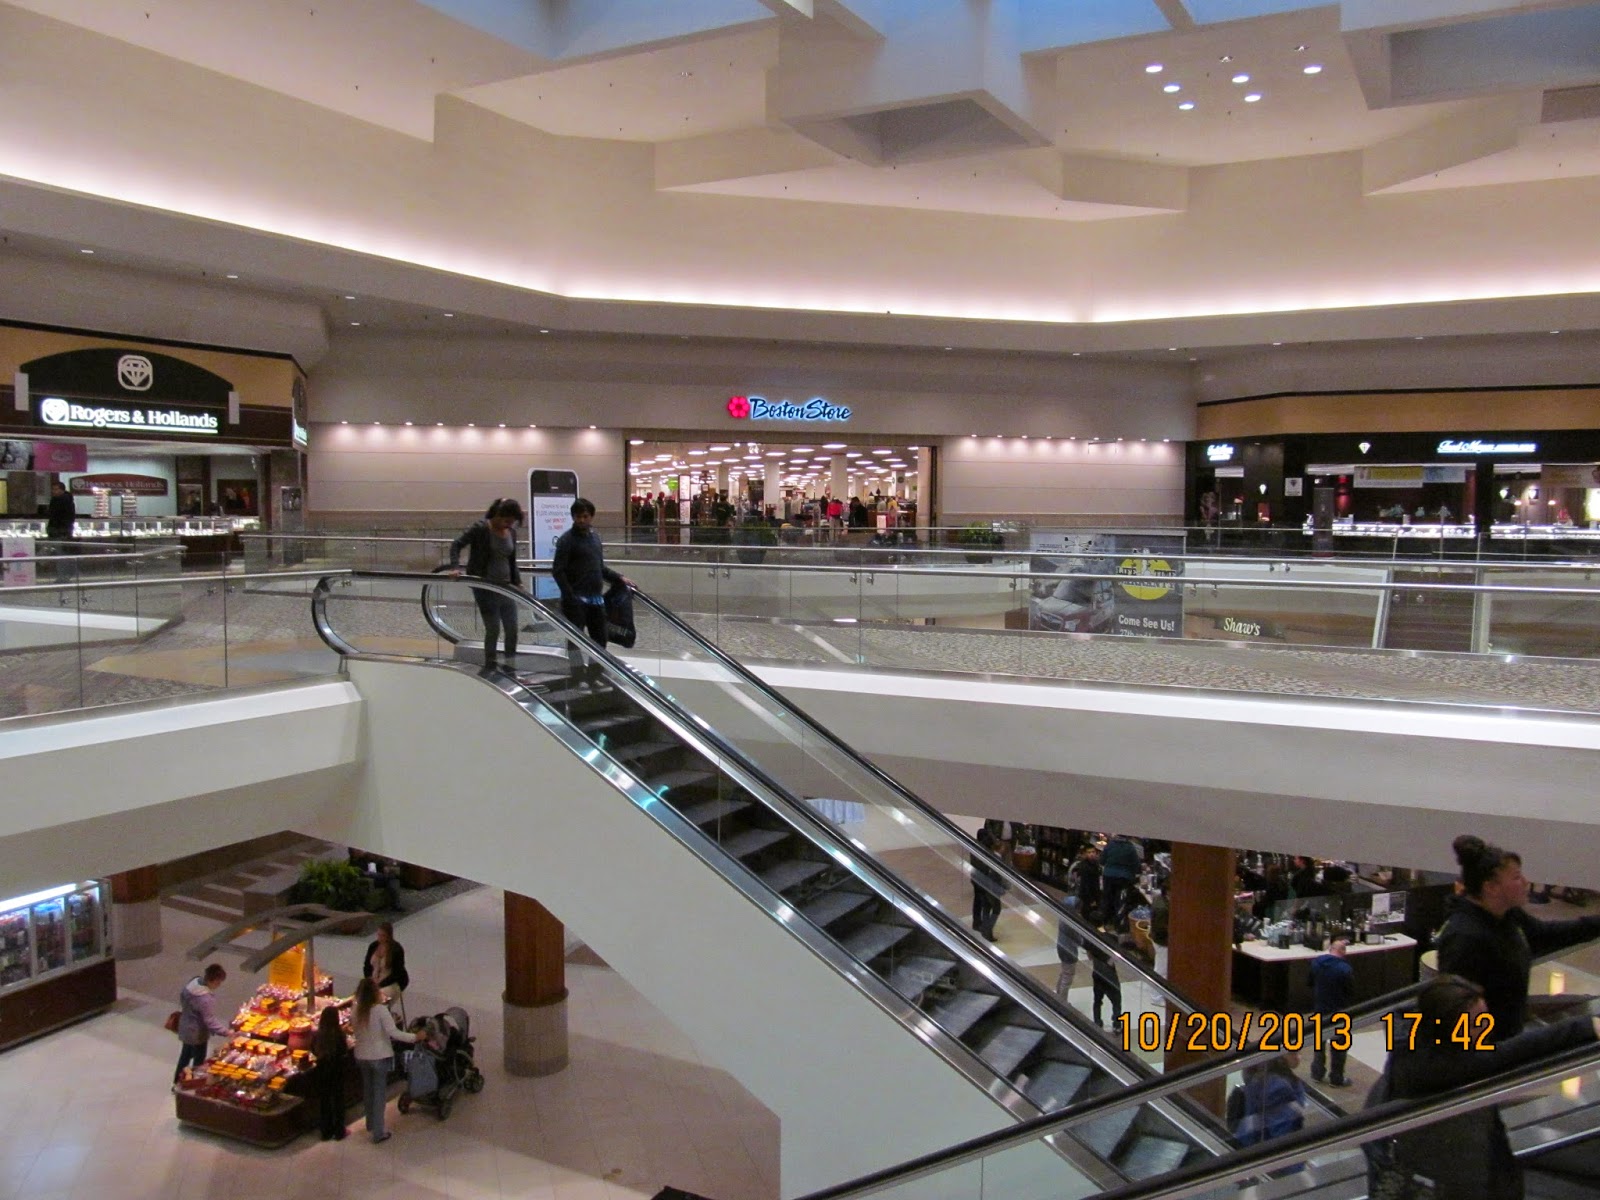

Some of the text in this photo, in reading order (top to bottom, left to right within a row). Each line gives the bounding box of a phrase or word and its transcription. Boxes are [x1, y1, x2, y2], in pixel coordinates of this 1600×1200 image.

[69, 404, 218, 429] Rogers & Hollands
[749, 397, 854, 420] Boston Store
[1116, 567, 1137, 576] LIFE
[1118, 614, 1175, 632] Come See Us!
[1223, 617, 1261, 636] Shaw's
